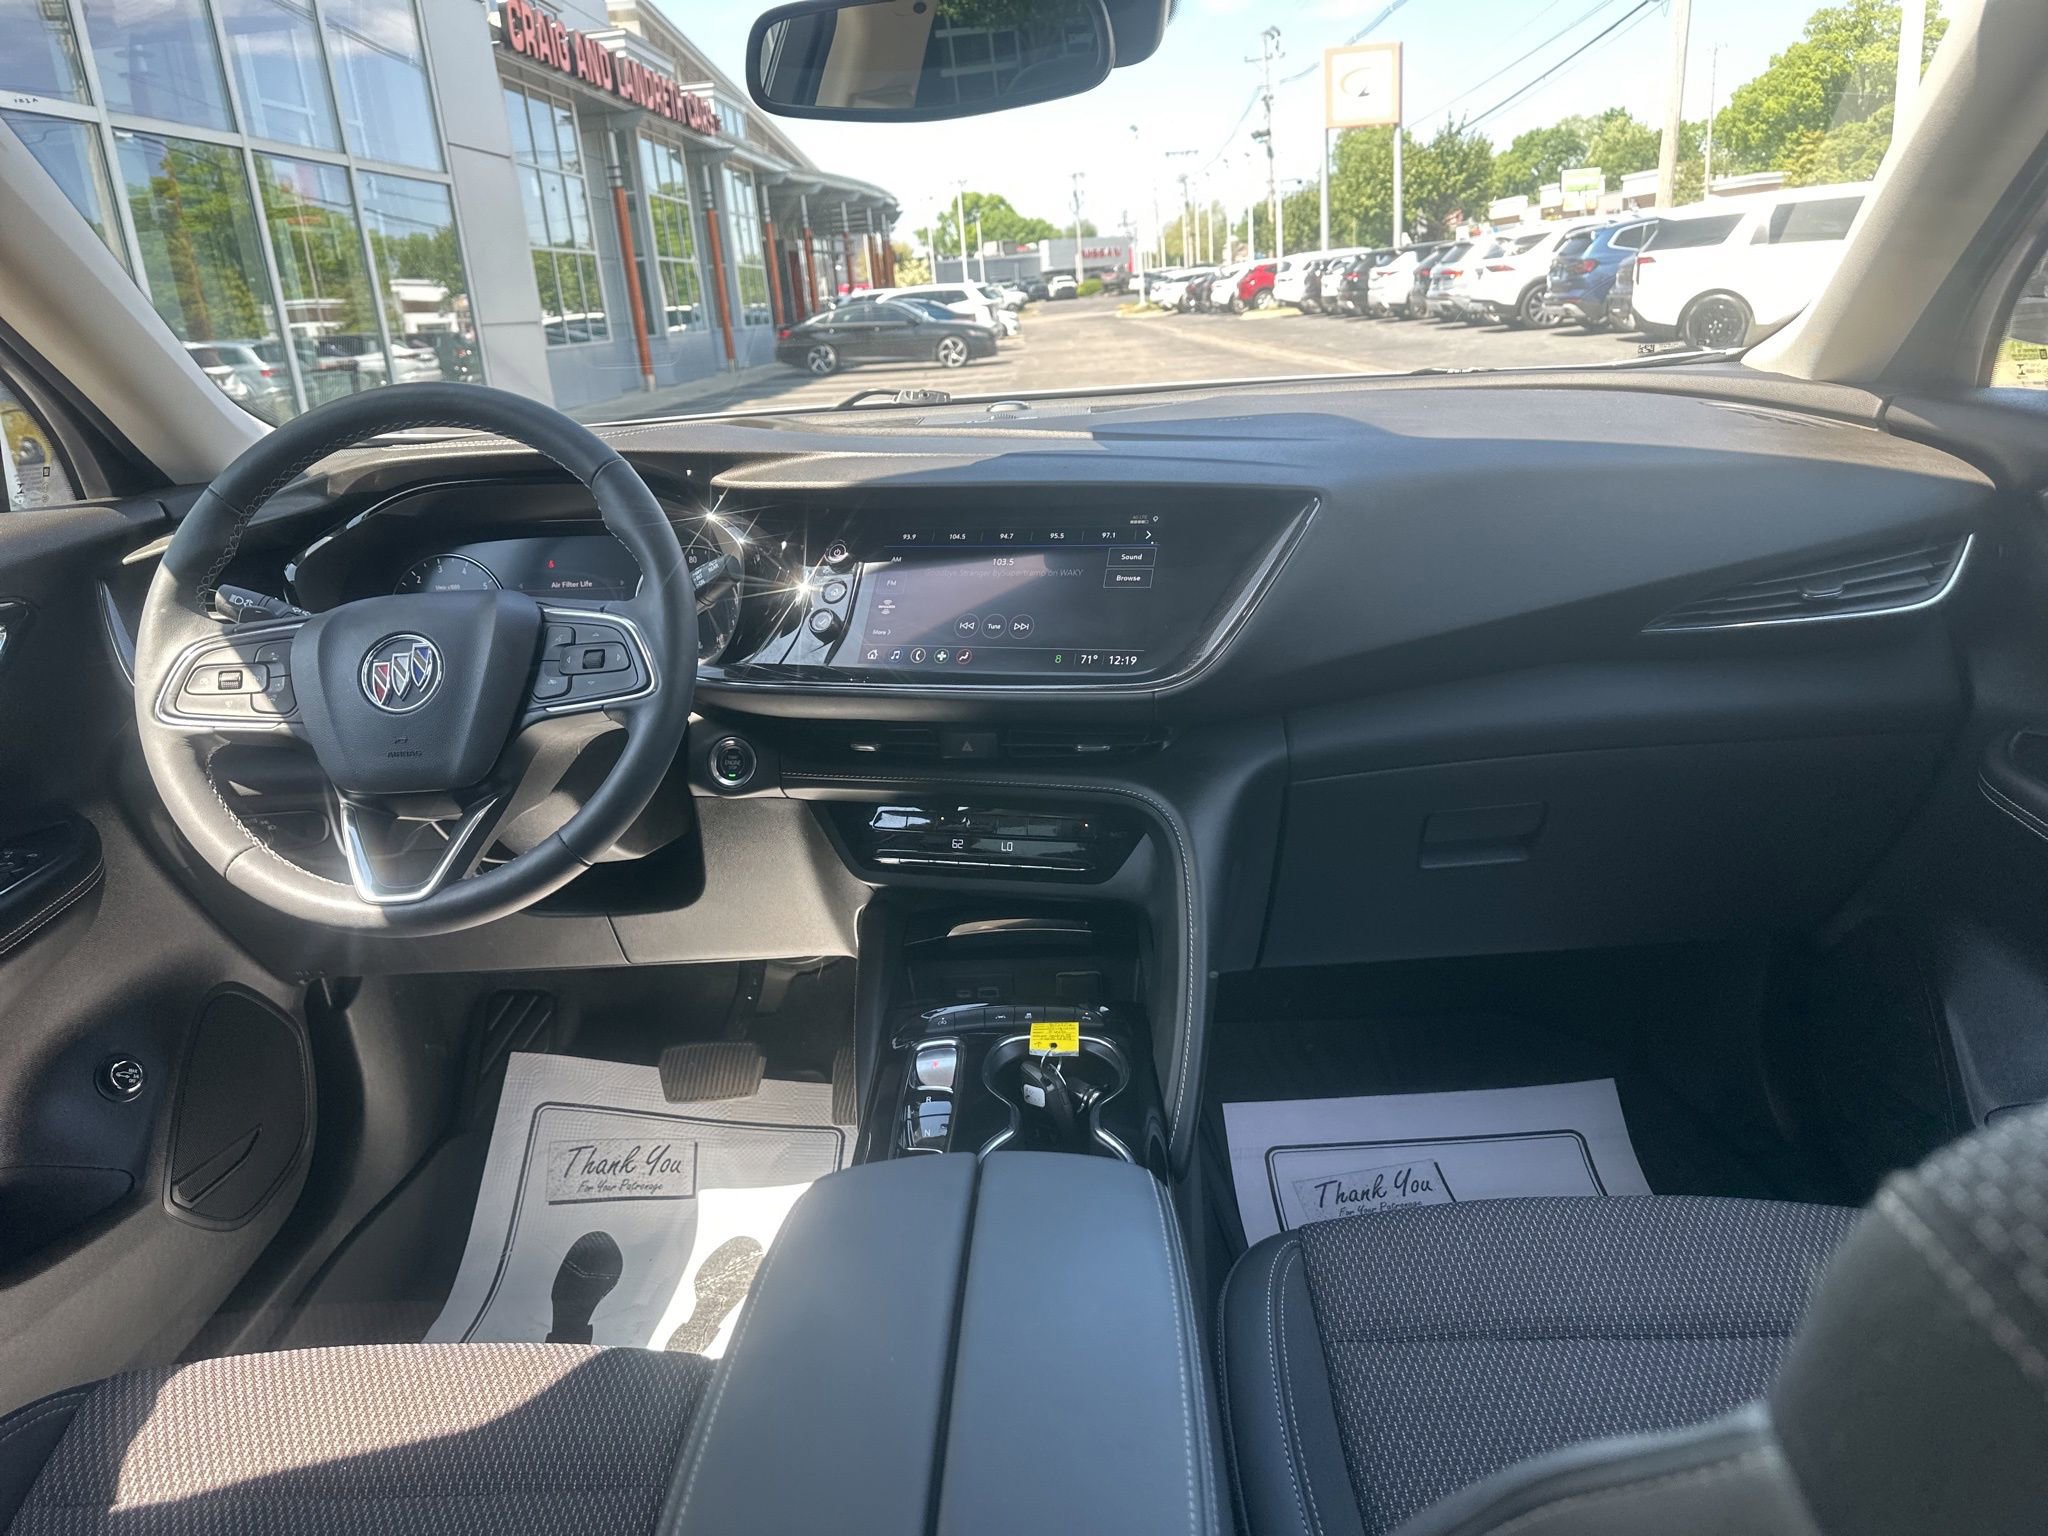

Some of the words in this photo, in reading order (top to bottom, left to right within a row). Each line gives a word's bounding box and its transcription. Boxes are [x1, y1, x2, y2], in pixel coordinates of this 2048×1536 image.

[506, 0, 571, 73] CRAIG
[574, 30, 613, 91] AND
[615, 56, 686, 124] LANDRETH
[992, 558, 1015, 566] 103.5
[437, 565, 443, 574] 3
[461, 567, 467, 575] 4
[1060, 568, 1083, 576] WAKY
[416, 575, 422, 584] 2
[1116, 574, 1141, 582] Browse
[482, 582, 488, 590] 5
[551, 580, 561, 588] Air
[562, 580, 578, 588] Filter
[580, 579, 593, 588] Life
[1080, 654, 1099, 665] 71°
[1108, 655, 1138, 665] 12:19
[951, 838, 964, 849] 62
[1001, 841, 1013, 852] LO
[925, 1095, 932, 1103] R
[924, 1128, 931, 1137] N
[563, 1144, 641, 1178] Thank
[645, 1143, 682, 1176] You
[577, 1180, 594, 1193] For
[597, 1180, 617, 1193] Your
[618, 1178, 664, 1194] Patronage
[1314, 1173, 1388, 1208] Thank
[1393, 1167, 1433, 1197] You
[1338, 1205, 1355, 1217] For
[1357, 1204, 1377, 1215] Your
